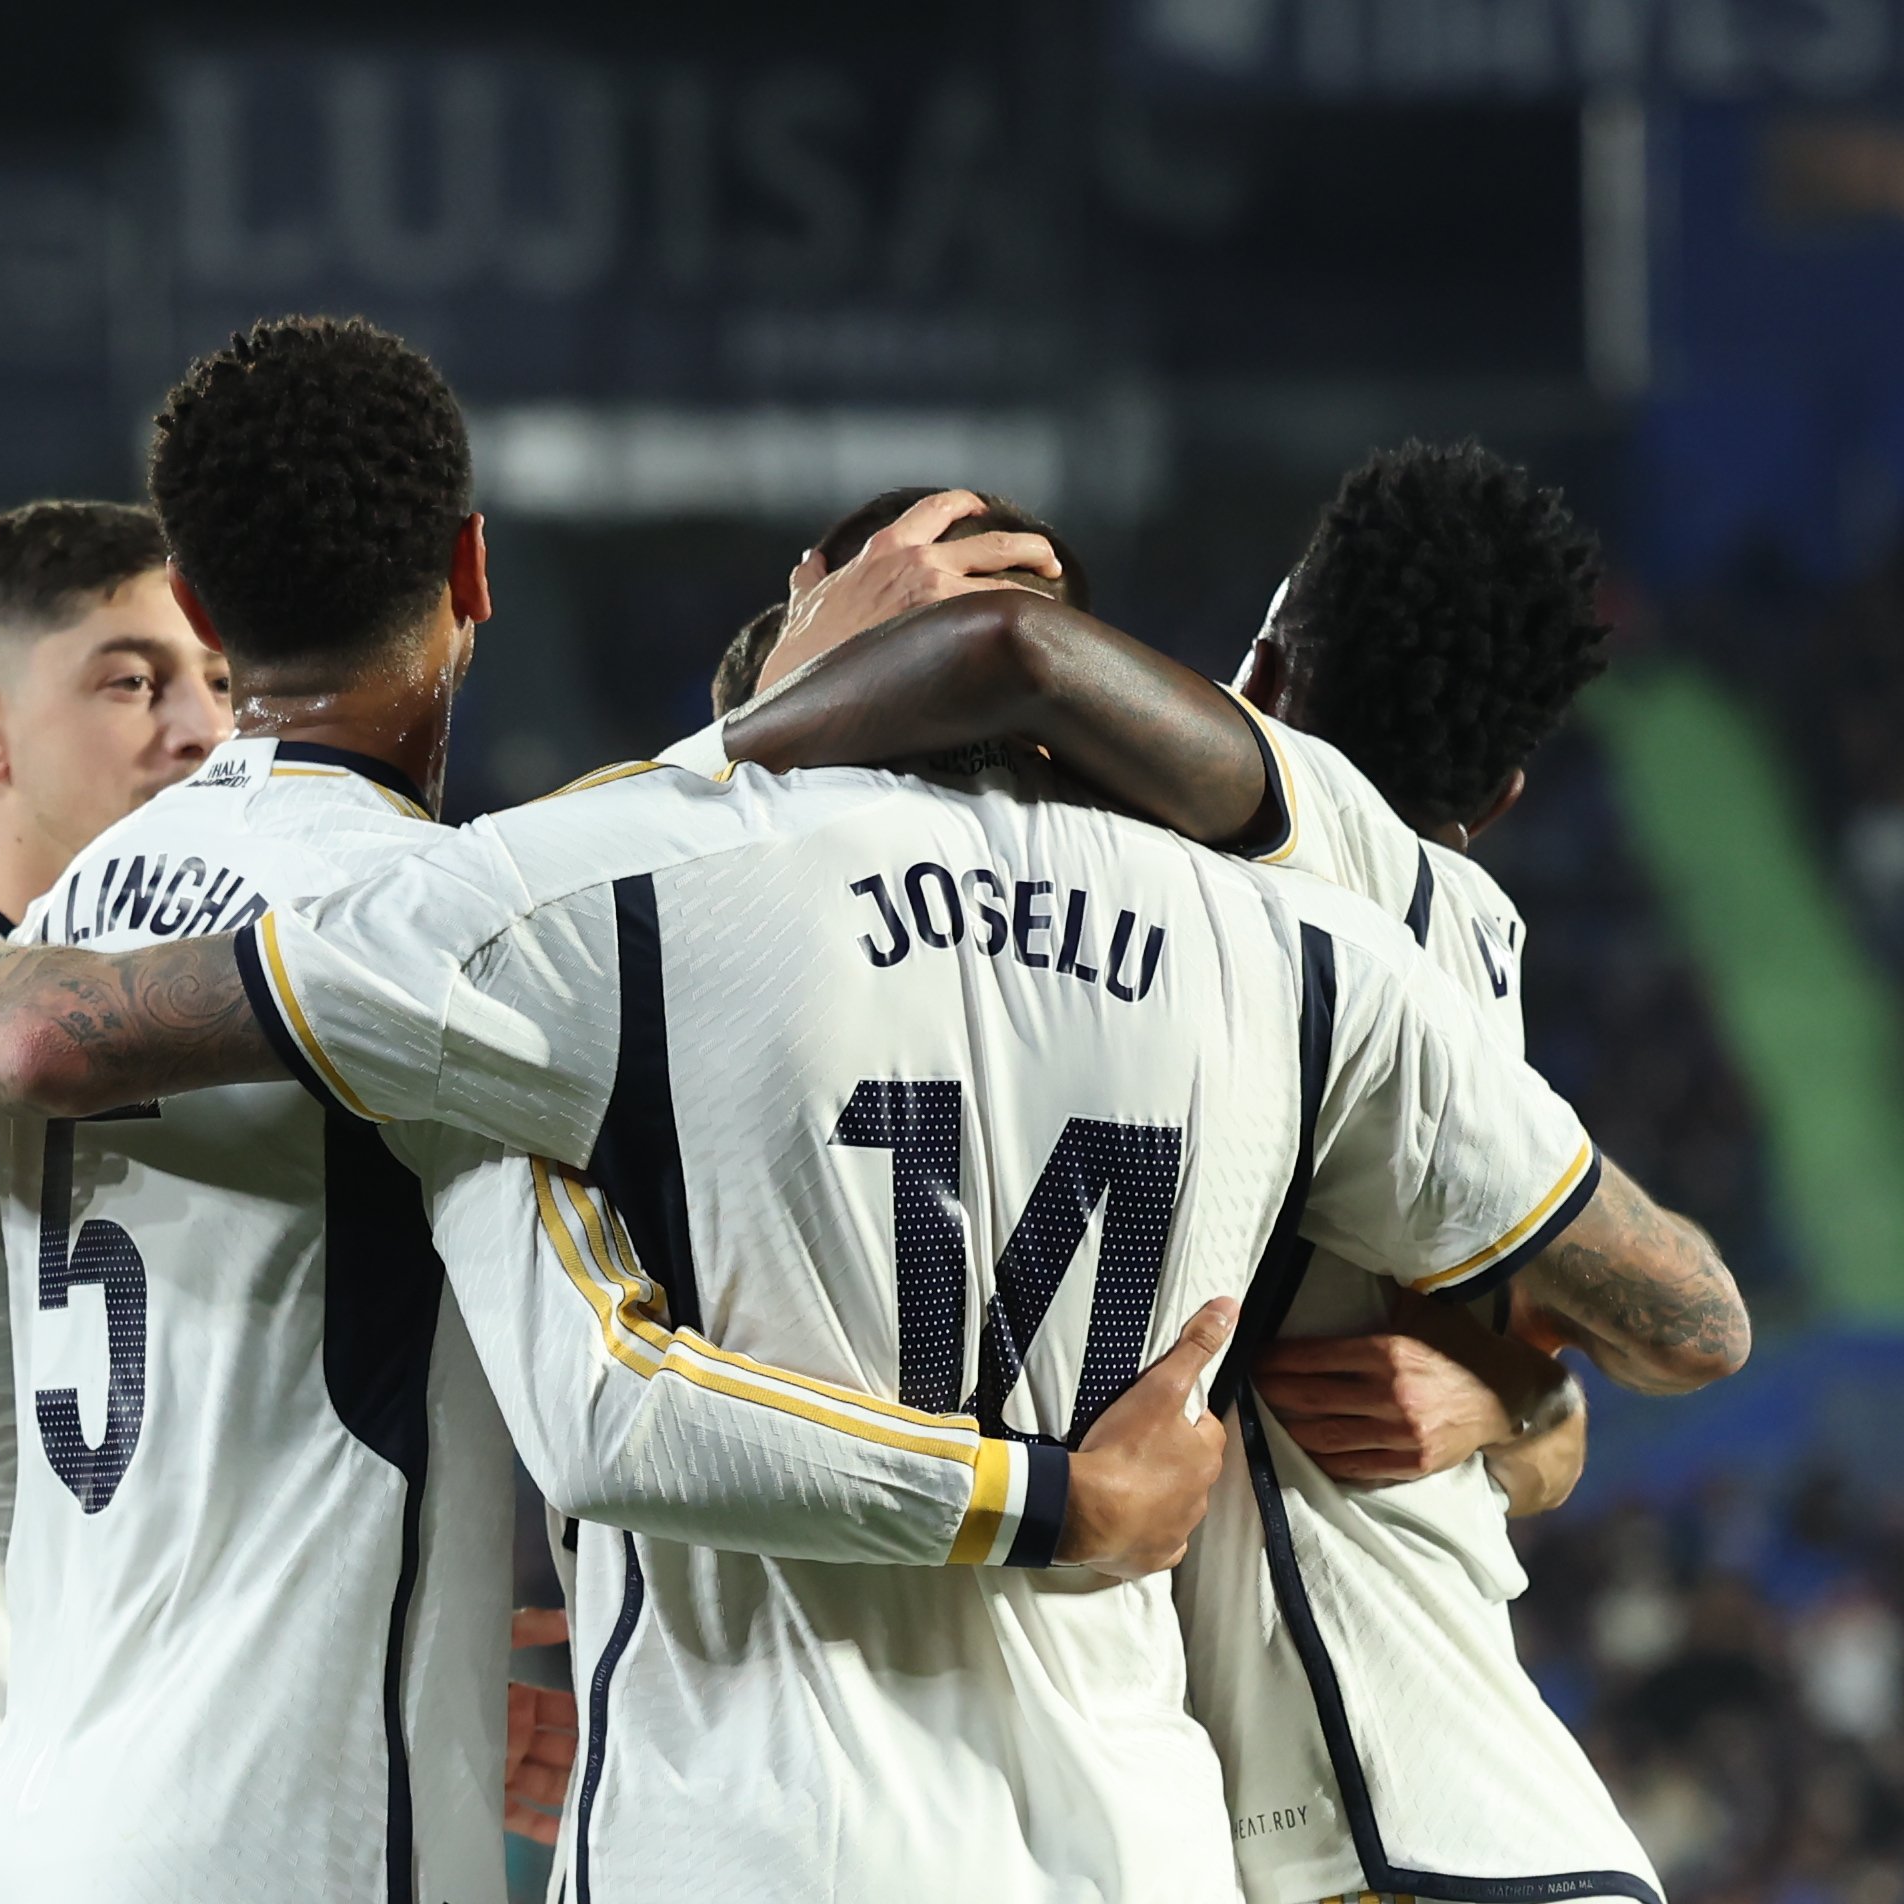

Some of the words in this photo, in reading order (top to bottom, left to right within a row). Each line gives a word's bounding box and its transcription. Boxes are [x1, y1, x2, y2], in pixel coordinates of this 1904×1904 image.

[42, 853, 270, 945] LINGHA
[848, 861, 1167, 1005] JOSELU
[34, 1102, 162, 1516] 5
[826, 1079, 1184, 1444] 14
[1547, 1880, 1577, 1895] NADA
